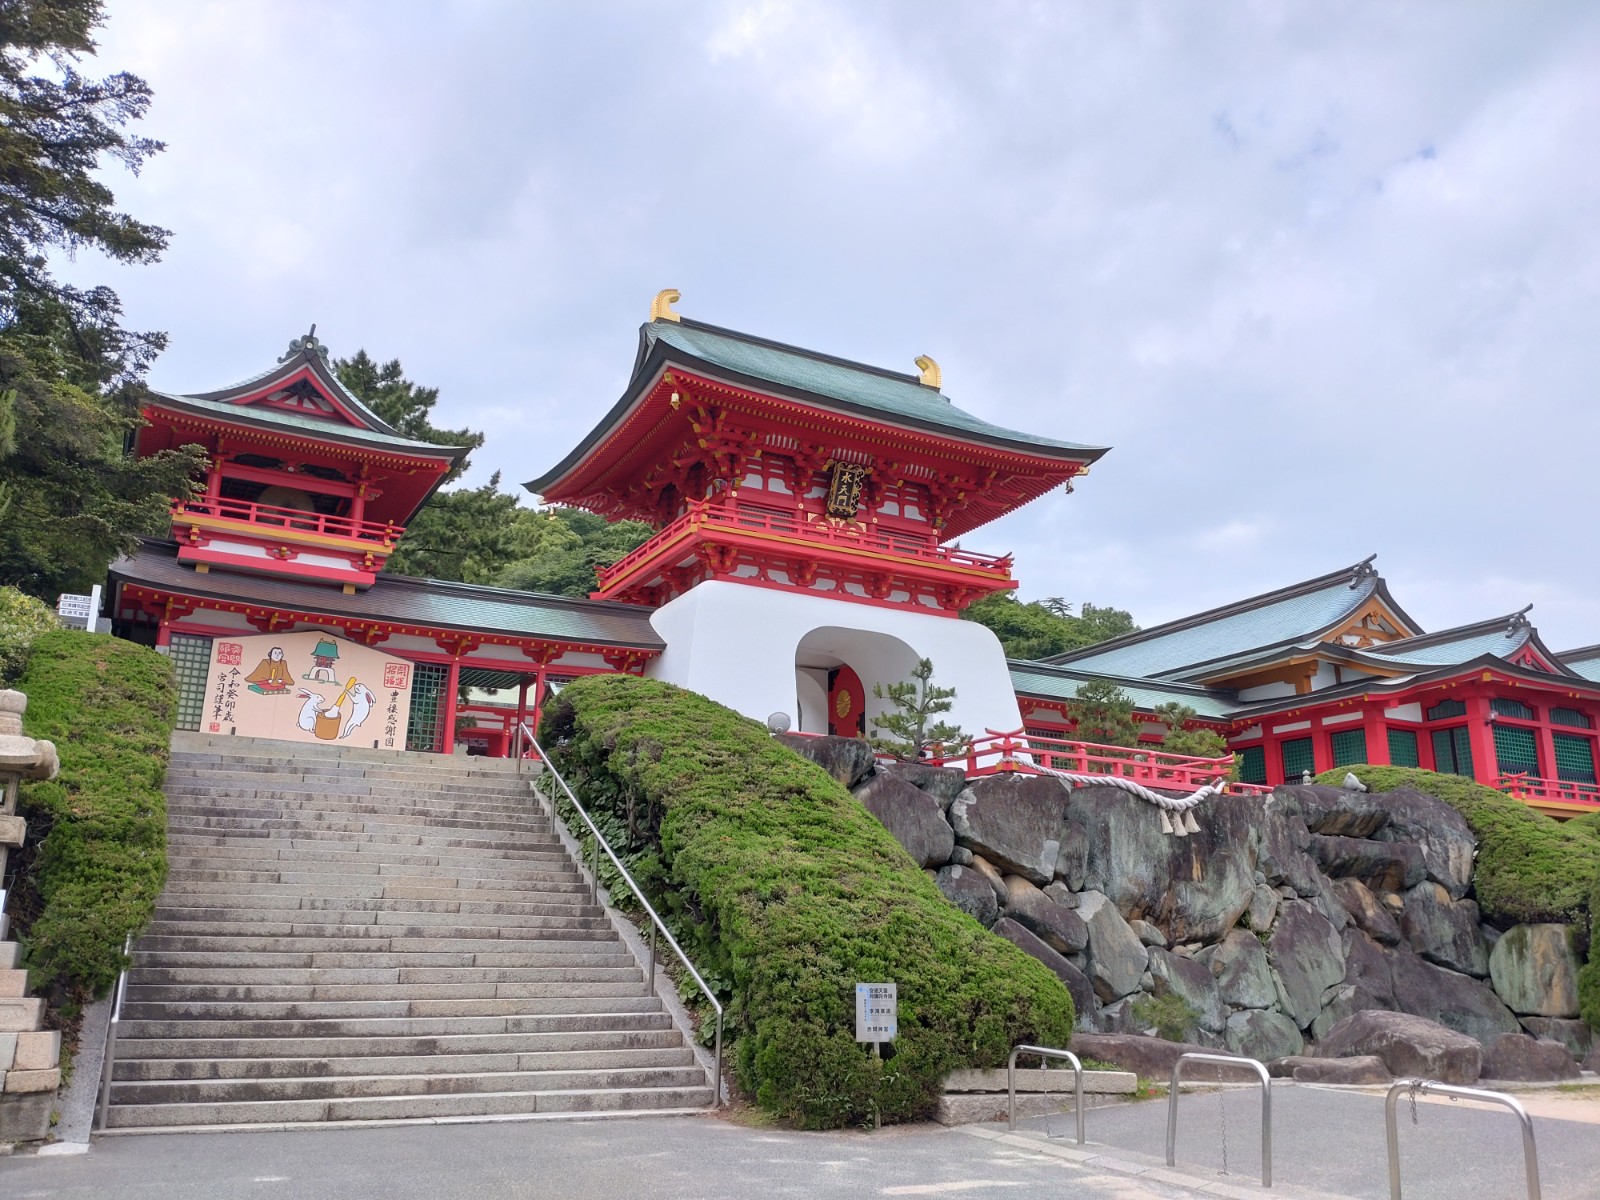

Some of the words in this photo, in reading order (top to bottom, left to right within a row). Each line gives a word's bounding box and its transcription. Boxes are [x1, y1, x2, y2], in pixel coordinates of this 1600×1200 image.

[837, 472, 852, 506] 水天門
[213, 672, 227, 721] 宮司謹筆
[223, 667, 241, 723] 令和癸卯歳
